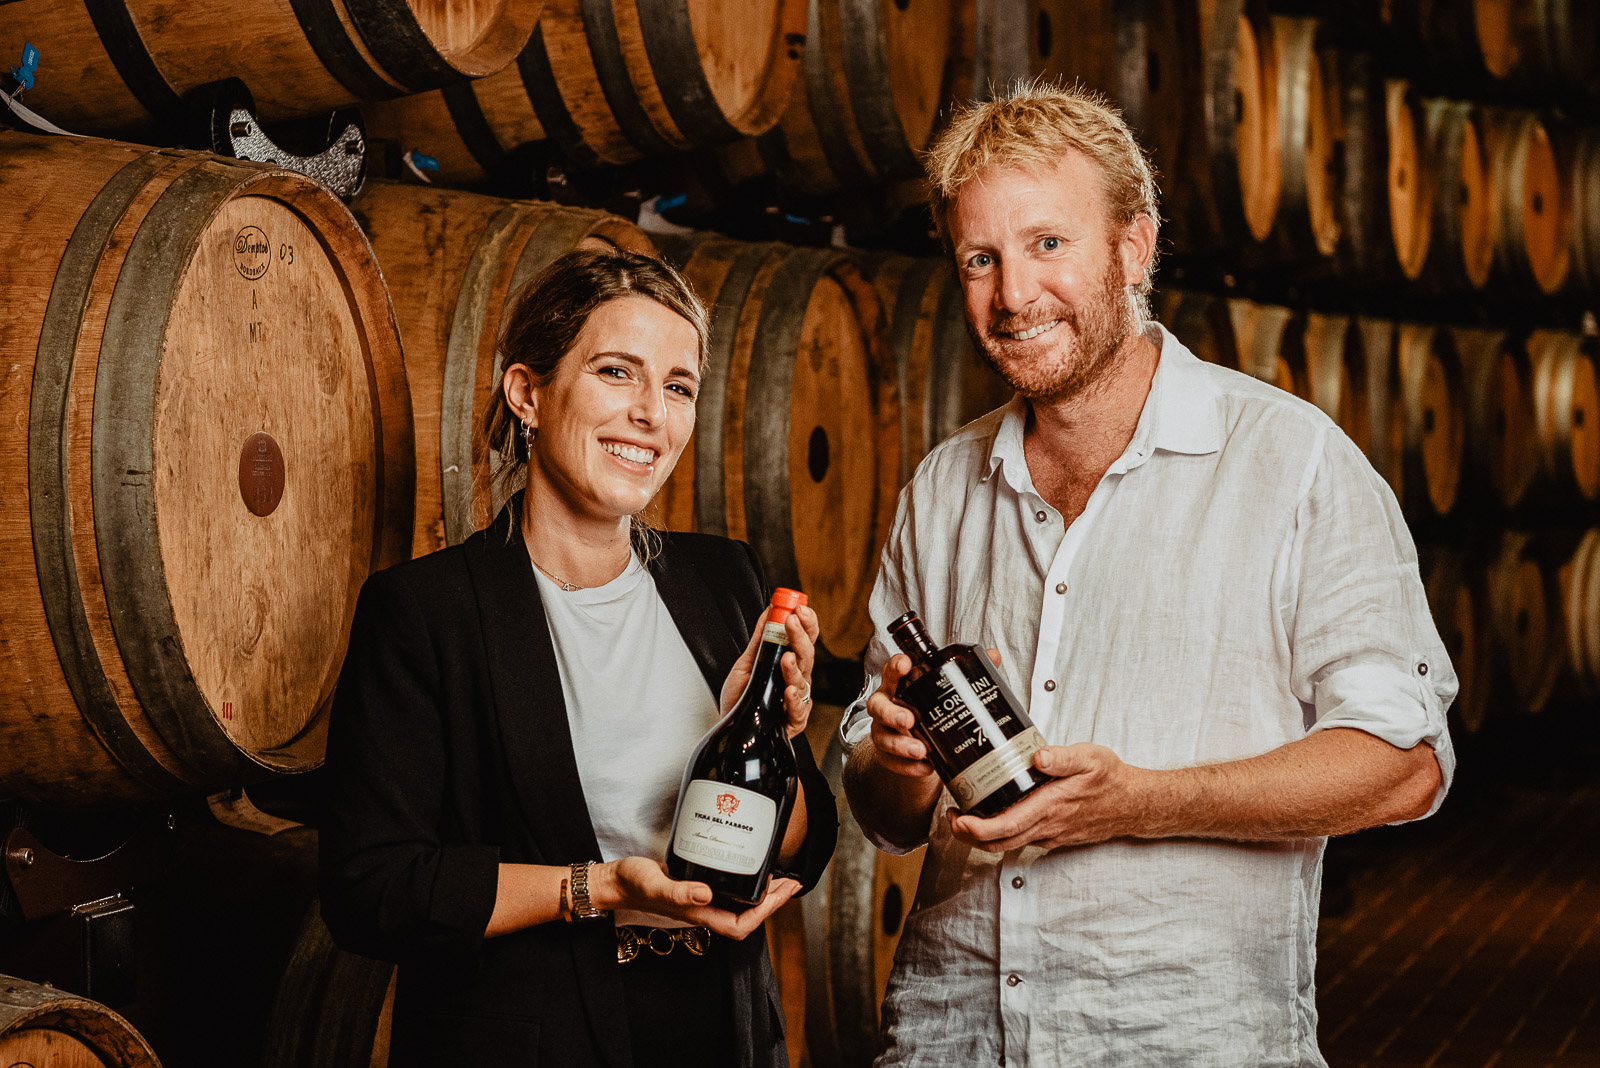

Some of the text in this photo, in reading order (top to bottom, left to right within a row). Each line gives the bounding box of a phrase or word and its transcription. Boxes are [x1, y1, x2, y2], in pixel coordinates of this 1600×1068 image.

[929, 706, 944, 721] LE
[943, 676, 991, 711] ORINI
[694, 812, 754, 832] VIGNA DEL PARROCO
